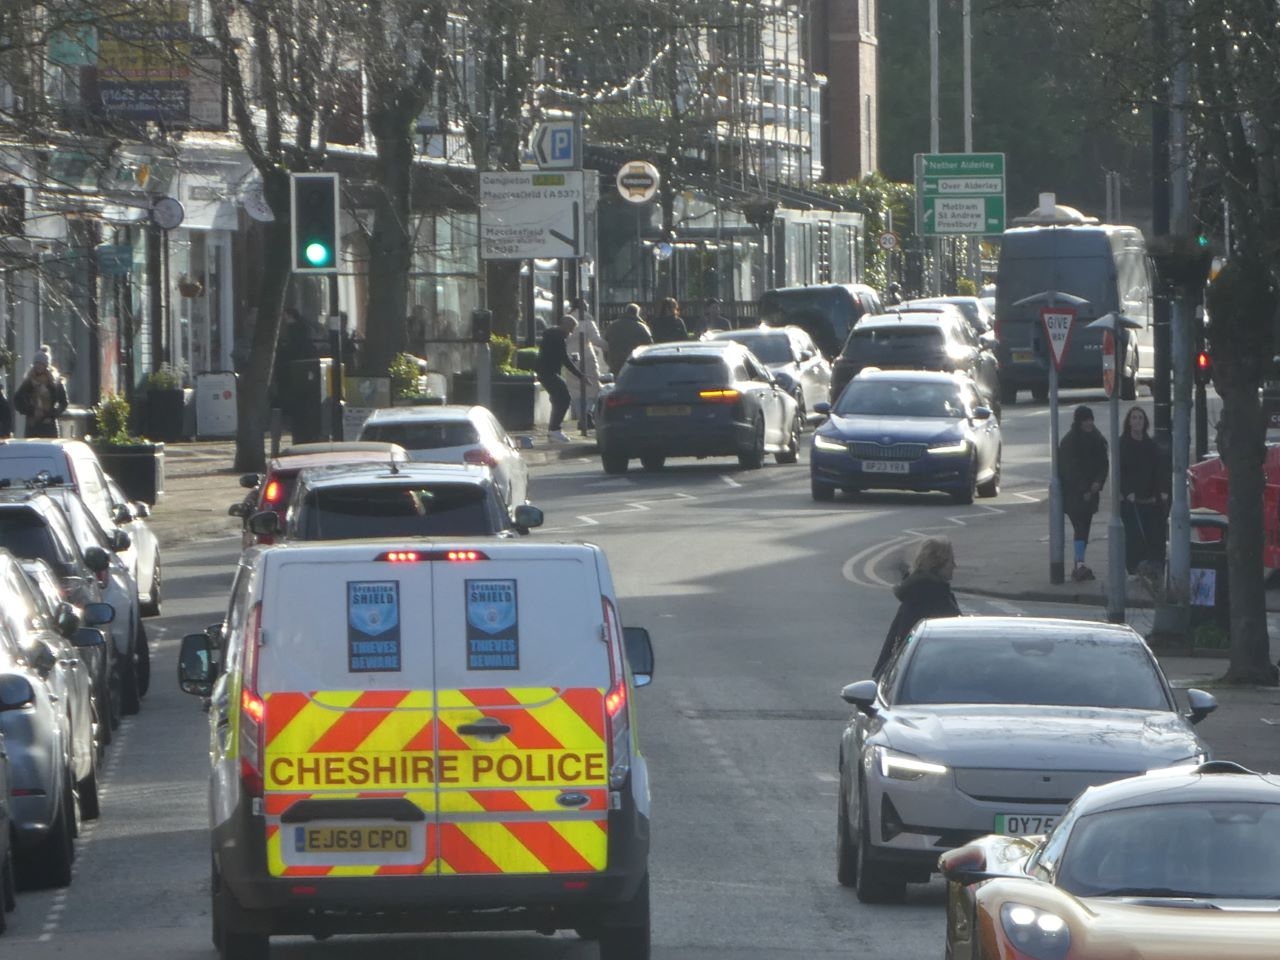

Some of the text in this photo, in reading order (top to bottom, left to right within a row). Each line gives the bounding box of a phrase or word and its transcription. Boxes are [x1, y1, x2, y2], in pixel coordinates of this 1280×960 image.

[555, 132, 568, 157] P
[929, 161, 994, 169] Nether Alderley
[964, 182, 998, 190] Alderley
[544, 190, 580, 199] (A537)
[950, 211, 982, 219] Andrew
[938, 220, 977, 229] Prestbury
[1048, 316, 1068, 329] GIVE
[471, 584, 512, 592] OPERATION
[353, 593, 394, 605] SHIELD
[471, 592, 512, 603] SHIELD
[352, 641, 398, 654] THIEVES
[470, 639, 516, 652] THIEVES
[351, 655, 399, 669] BEWARE
[470, 654, 517, 667] BEWARE
[270, 752, 605, 786] CHESHIRE POLICE
[308, 830, 408, 850] EJ69 CPO
